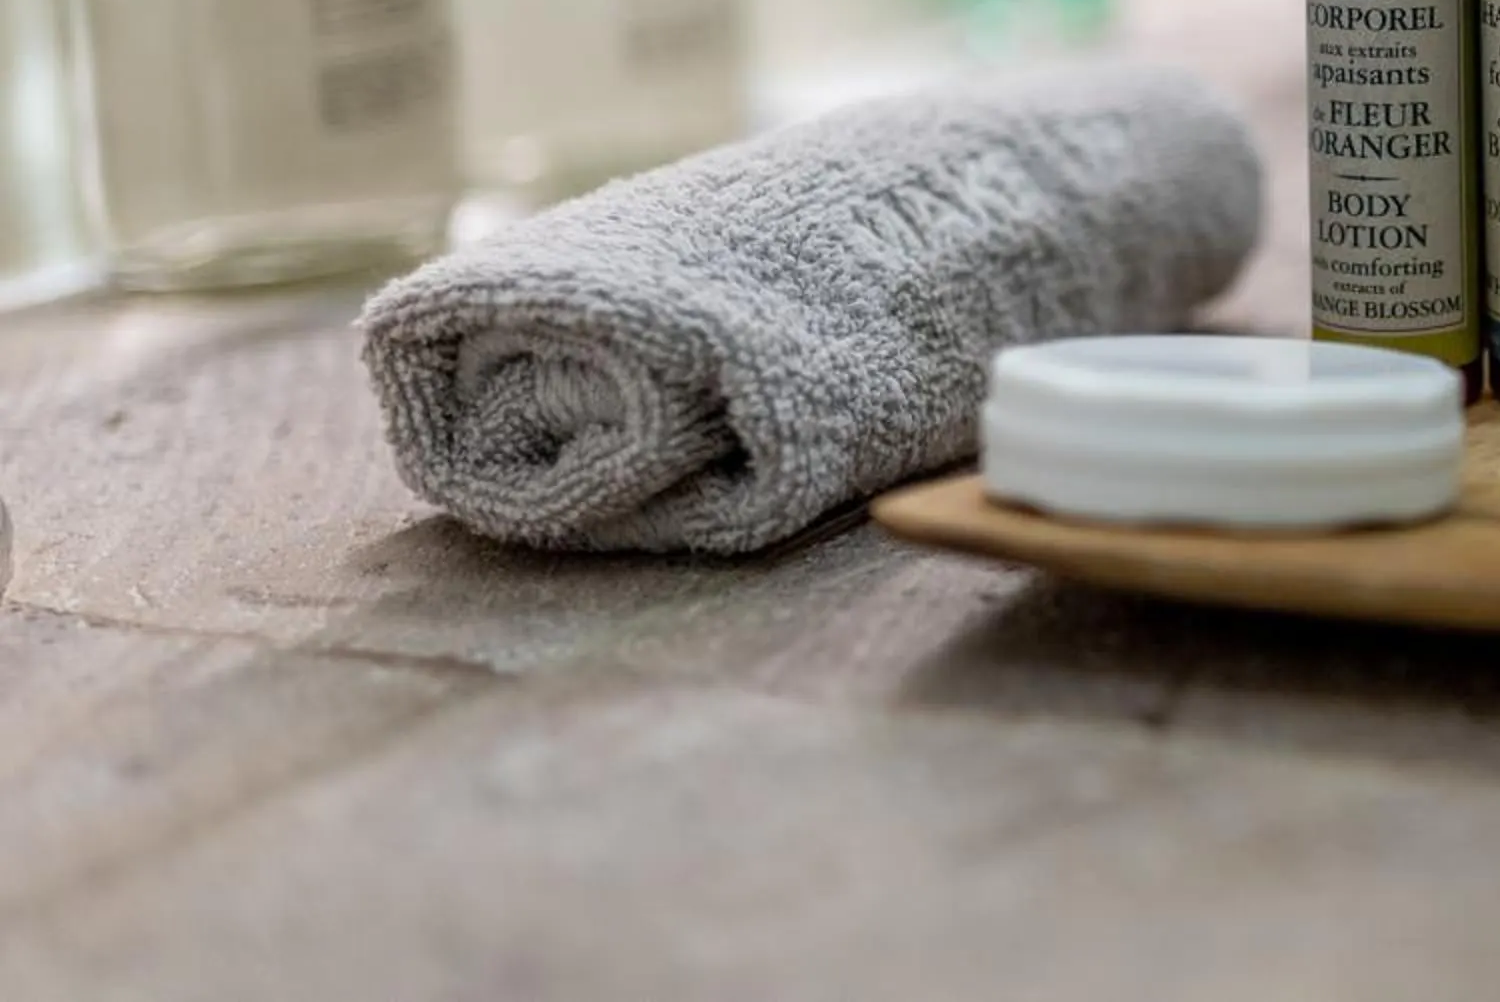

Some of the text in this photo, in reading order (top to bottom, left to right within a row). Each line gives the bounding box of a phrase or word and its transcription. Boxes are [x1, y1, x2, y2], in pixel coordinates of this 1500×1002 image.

[1320, 42, 1417, 59] aux extraits
[1313, 59, 1430, 88] apaisants
[1329, 99, 1431, 128] FLEUR
[1328, 190, 1412, 218] BODY
[1318, 219, 1429, 249] LOTION
[1331, 257, 1444, 279] comforting
[1333, 280, 1408, 295] extracts of
[1312, 291, 1462, 319] ANGE BLOSSOM
